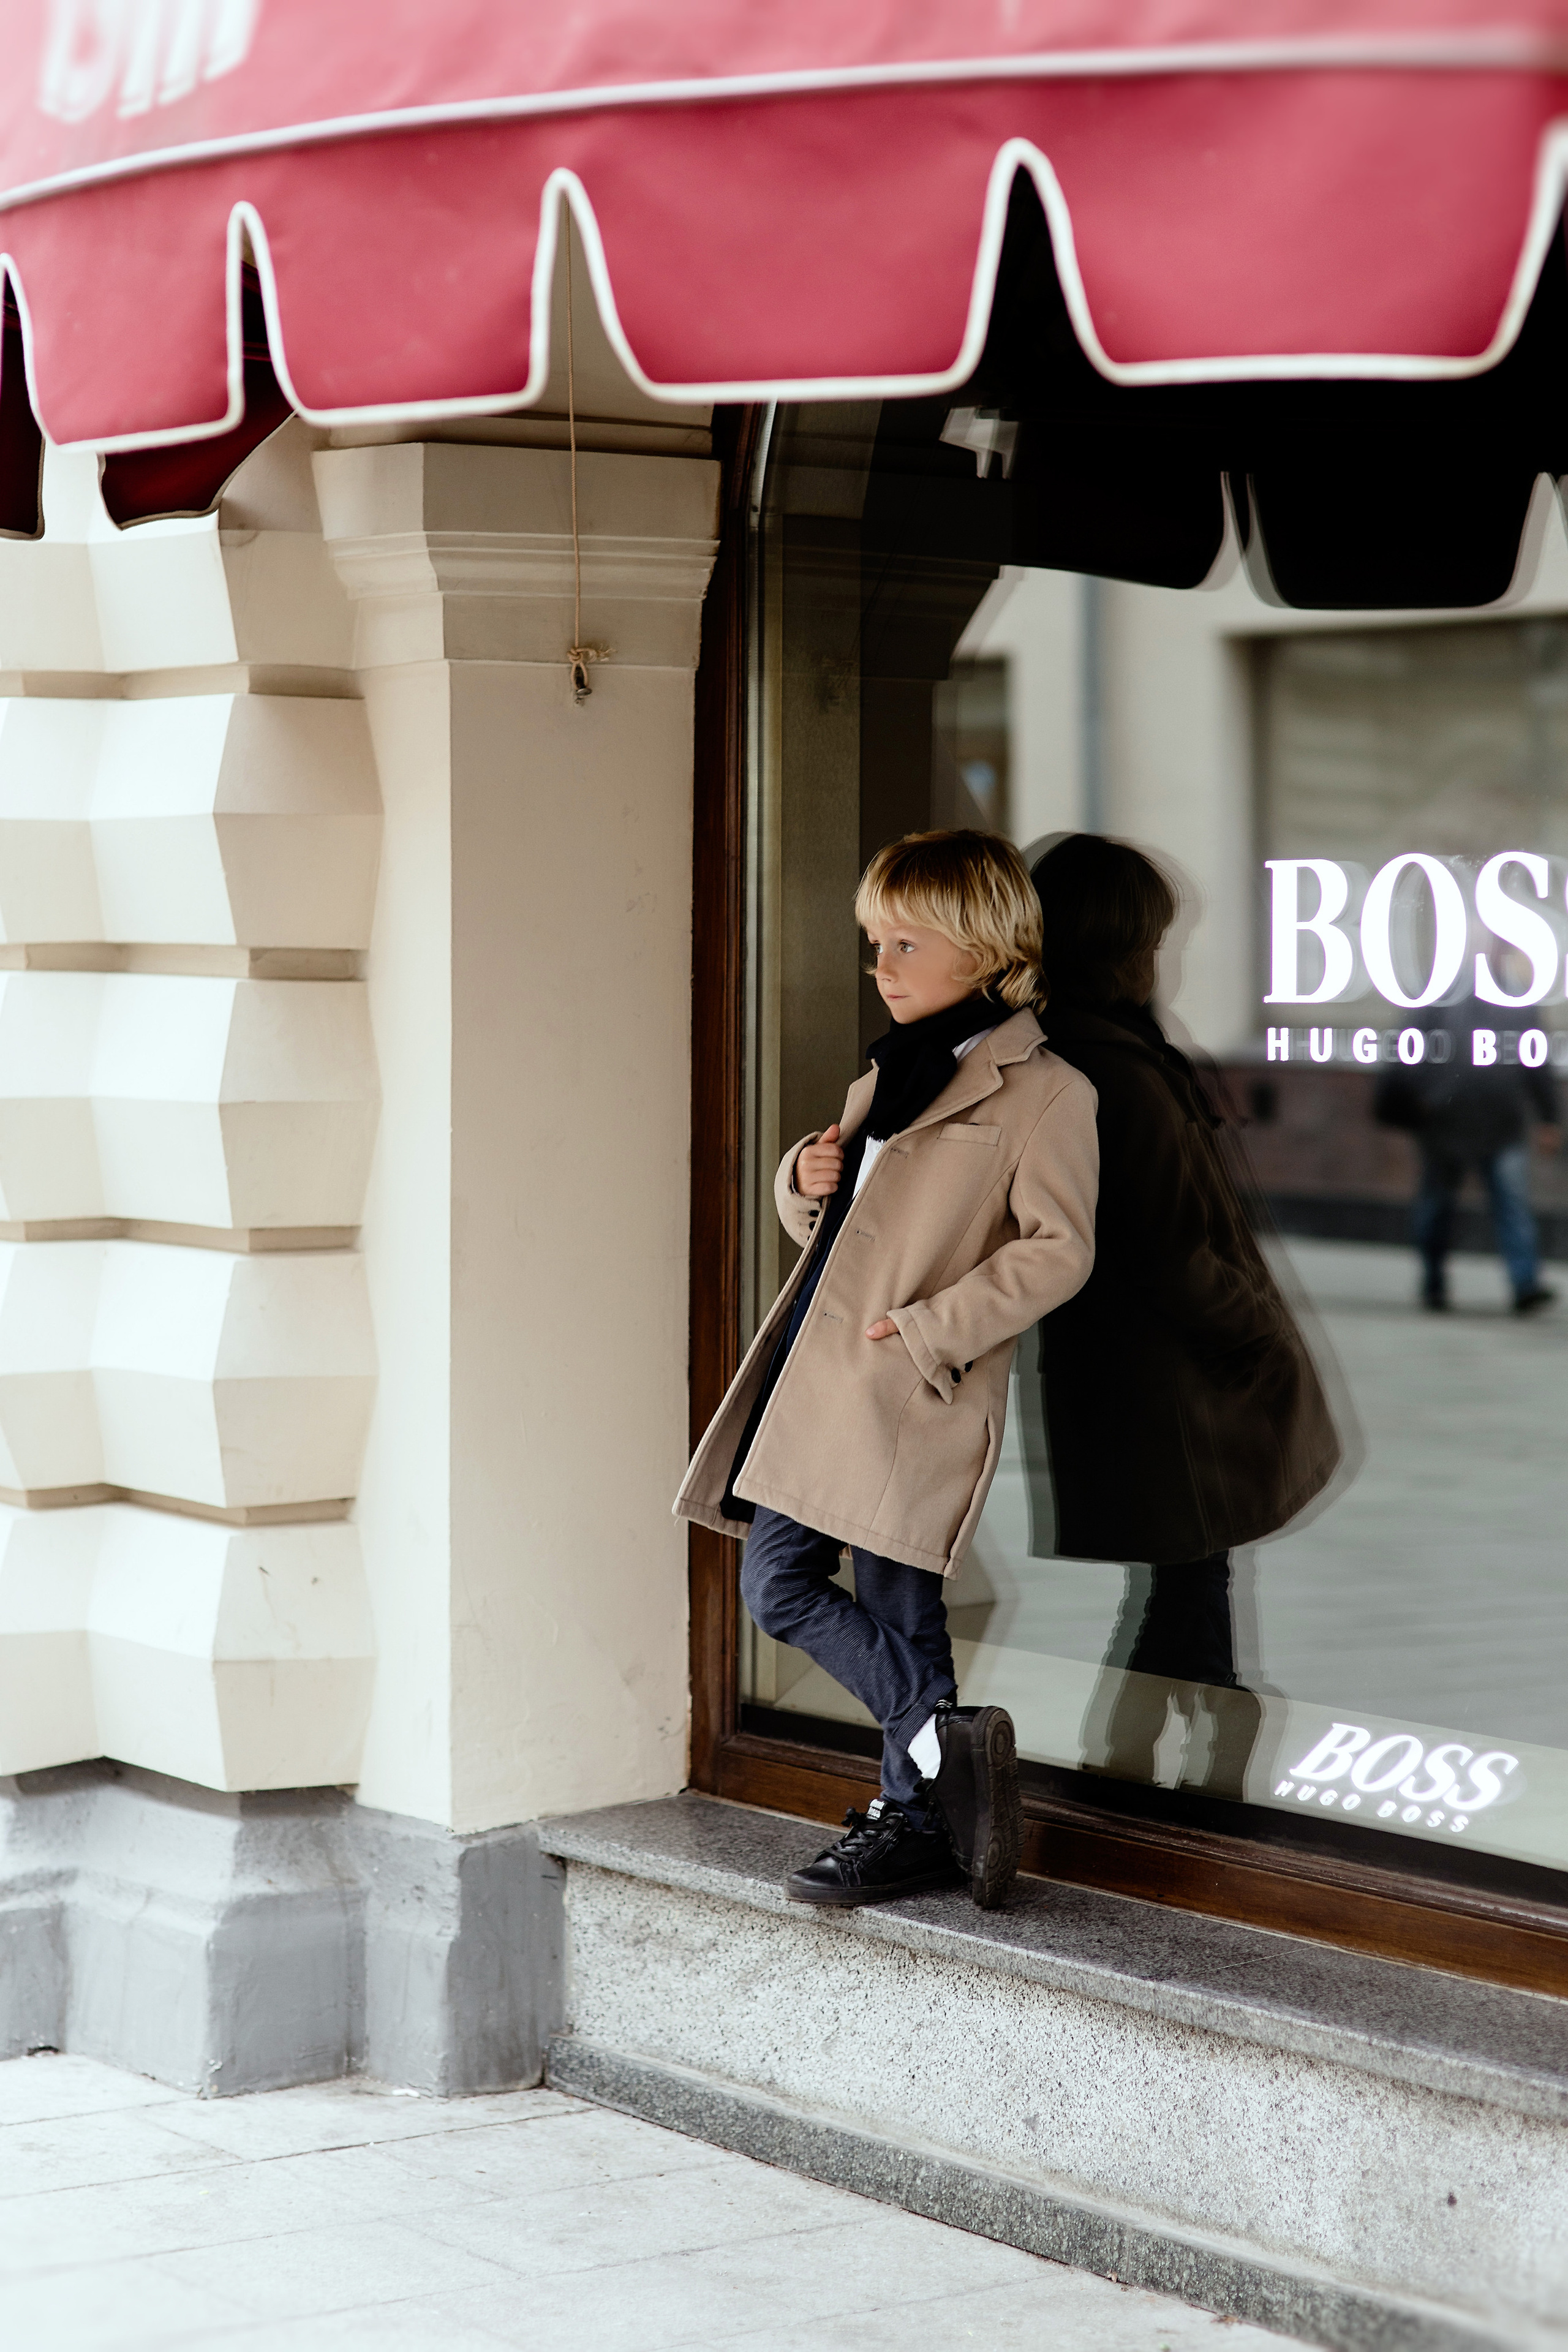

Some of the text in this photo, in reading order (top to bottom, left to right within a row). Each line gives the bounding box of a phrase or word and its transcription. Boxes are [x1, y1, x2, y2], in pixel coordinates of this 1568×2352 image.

[1263, 850, 1568, 1008] BOS
[1267, 1027, 1425, 1065] HUGO
[1289, 1722, 1520, 1812] BOSS
[1274, 1780, 1470, 1833] HUGO BOSS
